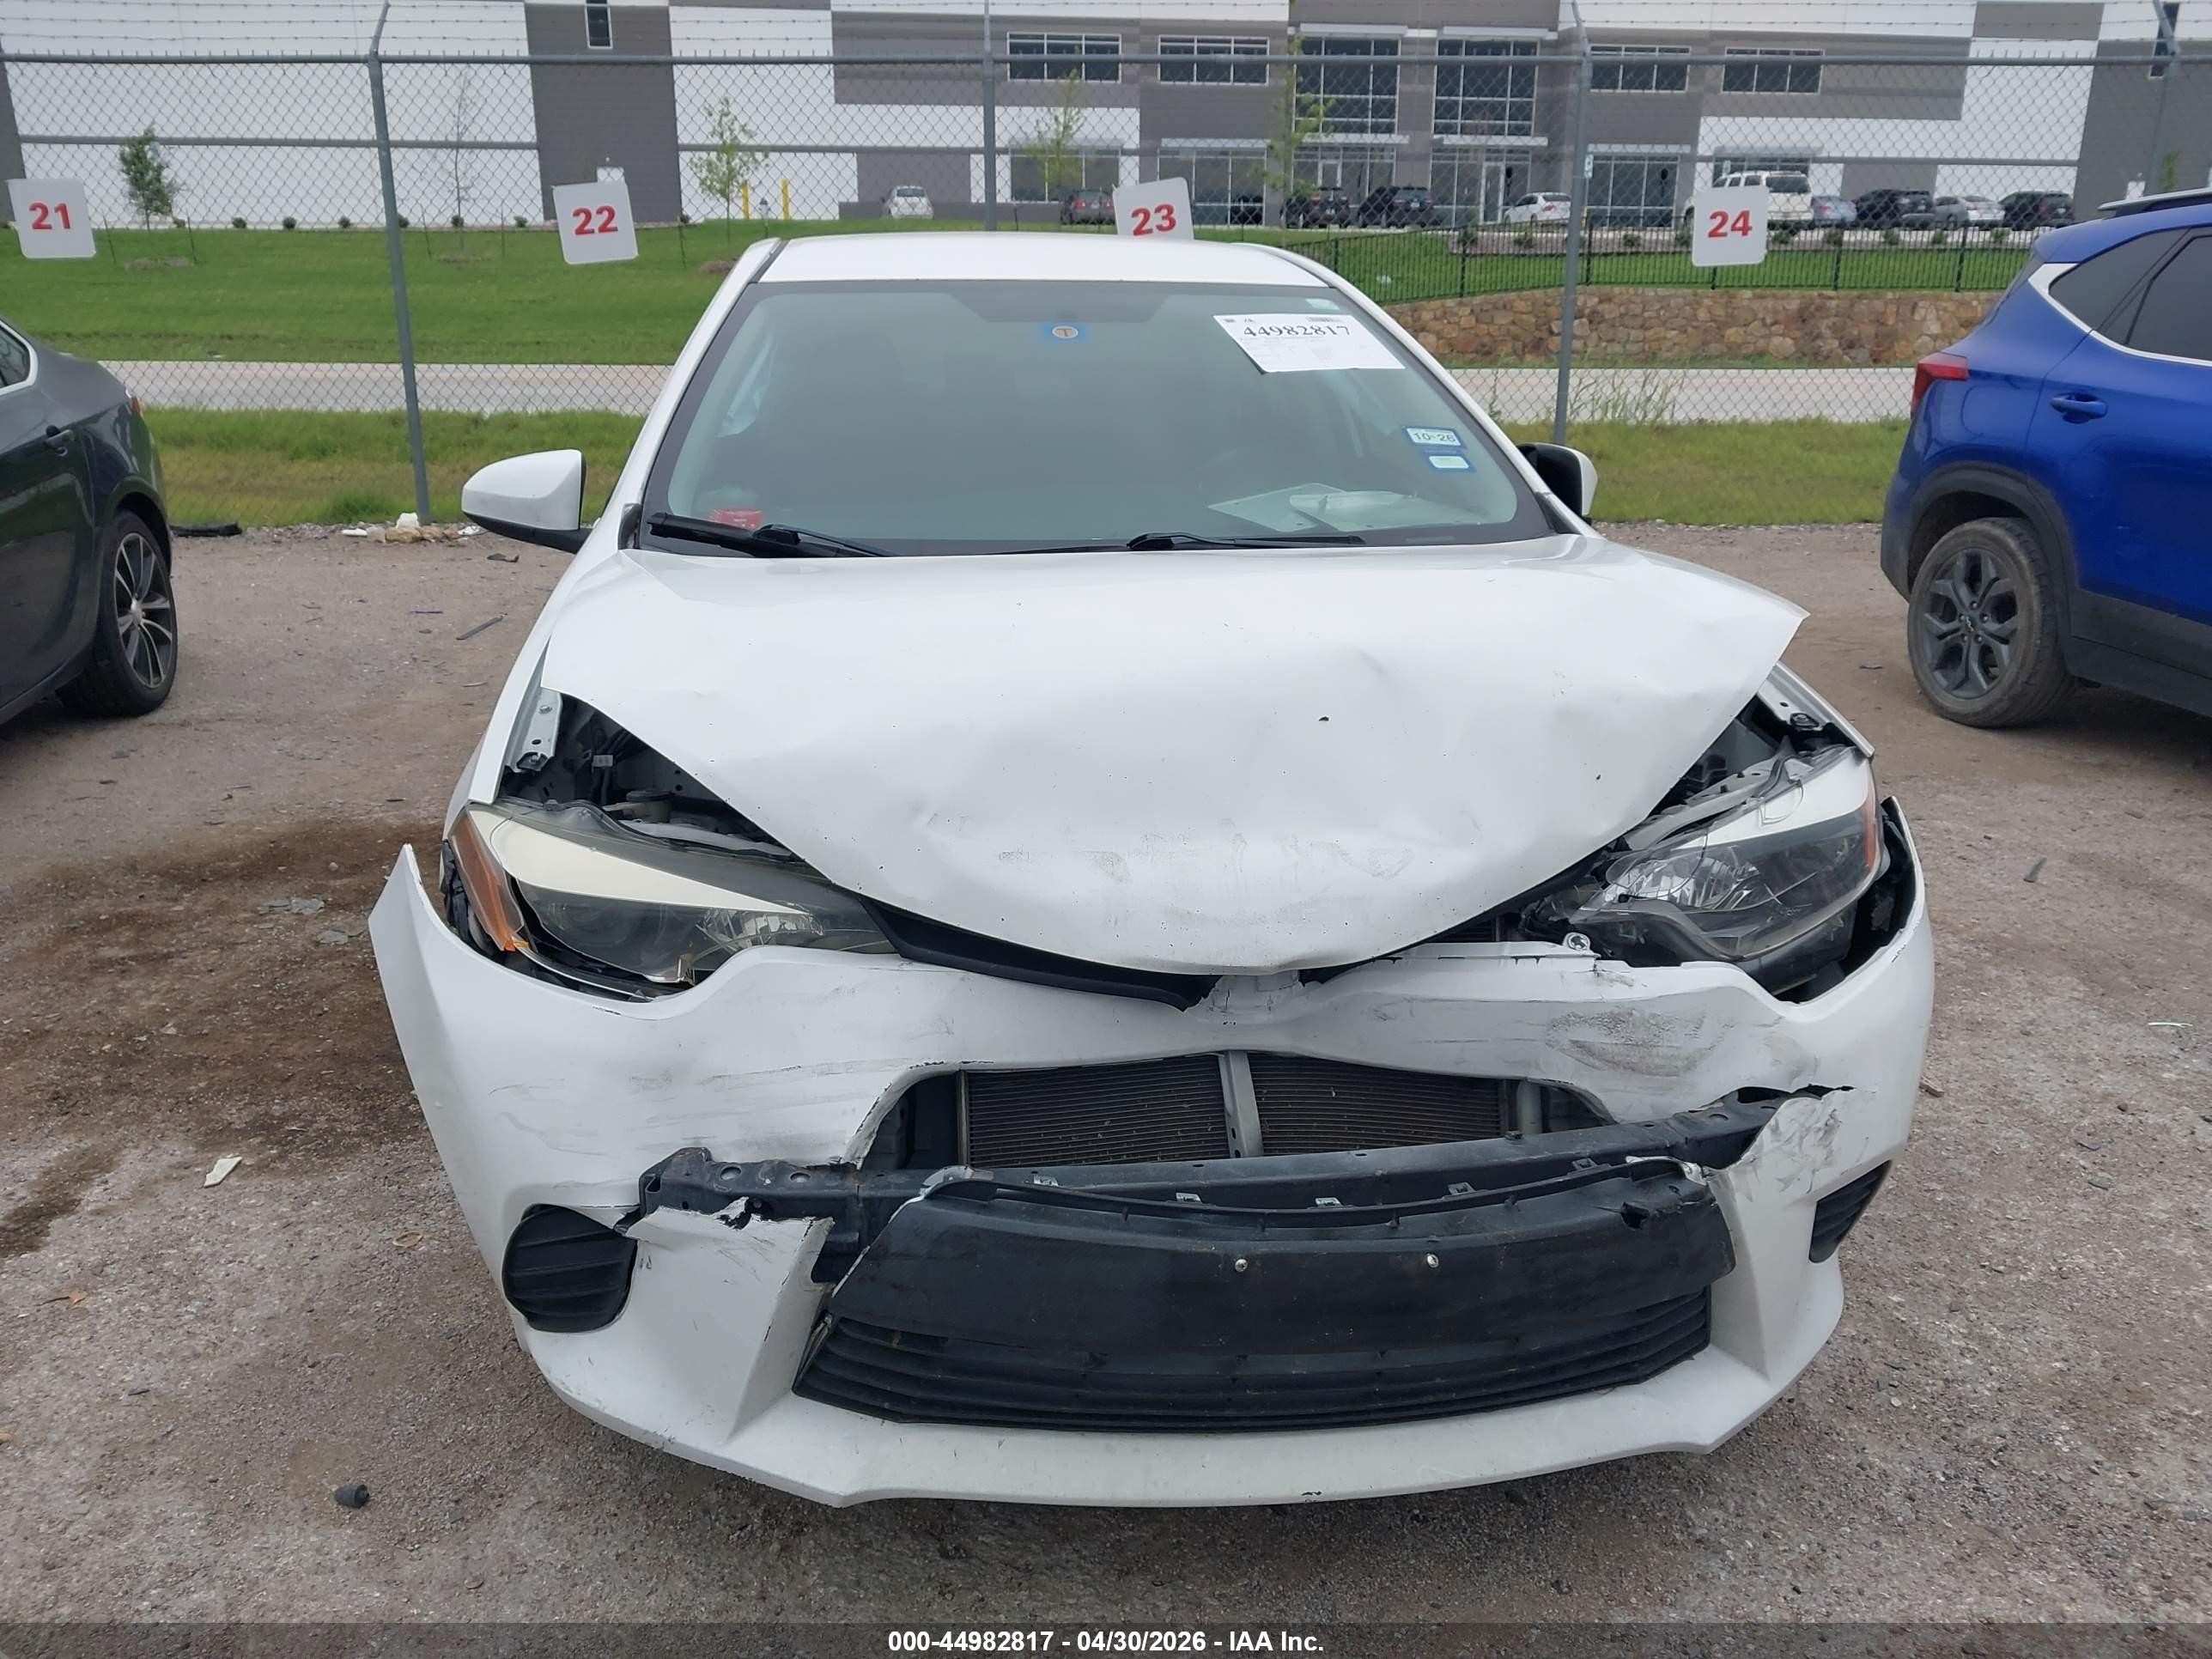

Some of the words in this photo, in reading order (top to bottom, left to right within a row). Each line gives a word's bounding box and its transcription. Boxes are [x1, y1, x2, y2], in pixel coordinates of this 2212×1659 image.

[28, 201, 71, 230] 21
[573, 206, 618, 235] 22
[1131, 204, 1177, 236] 23
[1707, 210, 1753, 239] 24
[1243, 325, 1352, 337] 44982817
